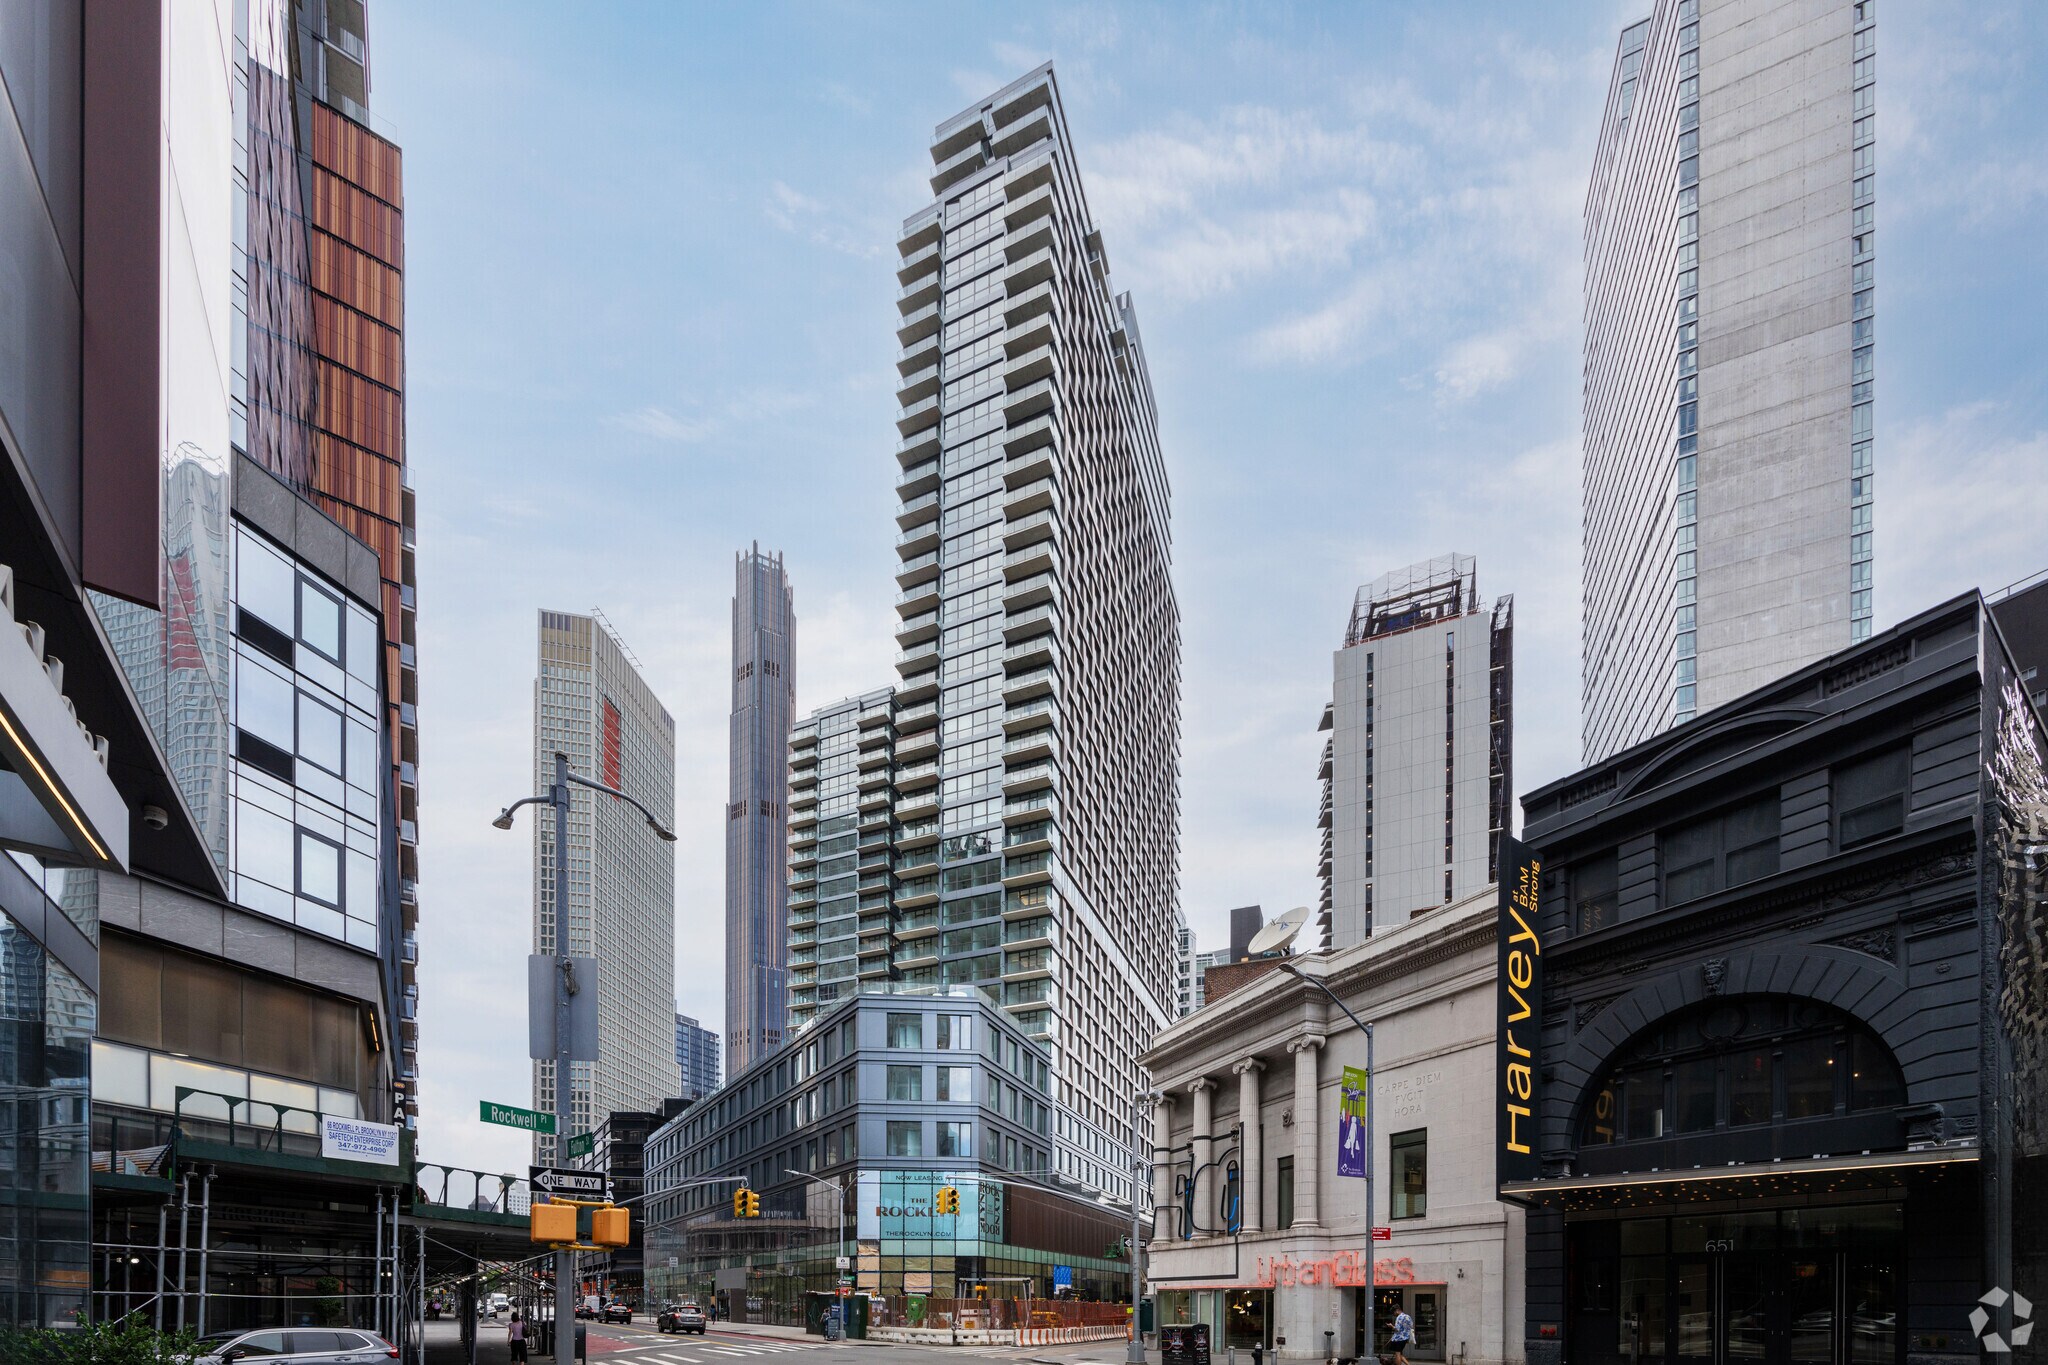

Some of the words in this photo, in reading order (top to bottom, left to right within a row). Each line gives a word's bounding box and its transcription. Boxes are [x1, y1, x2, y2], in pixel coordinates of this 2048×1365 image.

[1519, 866, 1529, 908] BAM
[1529, 859, 1541, 913] Strong
[1512, 889, 1519, 903] at
[1507, 906, 1540, 1155] Harvey
[1378, 1079, 1409, 1096] CARPE
[1416, 1072, 1441, 1087] DIEM
[491, 1105, 537, 1129] Rockwell
[540, 1114, 547, 1124] Pl
[1394, 1104, 1422, 1118] HORA
[333, 1121, 355, 1133] ROCKWELL
[361, 1126, 381, 1137] BROOKLYN
[328, 1131, 353, 1142] SAFETECH
[354, 1135, 381, 1147] ENTERPRISE
[382, 1139, 394, 1148] CORP
[337, 1141, 387, 1154] 347-972-4900
[542, 1175, 564, 1187] ONE
[574, 1177, 597, 1189] WAY
[876, 1206, 959, 1218] ROCKL
[1705, 1239, 1734, 1252] 651
[1257, 1250, 1415, 1289] UrbanGlass
